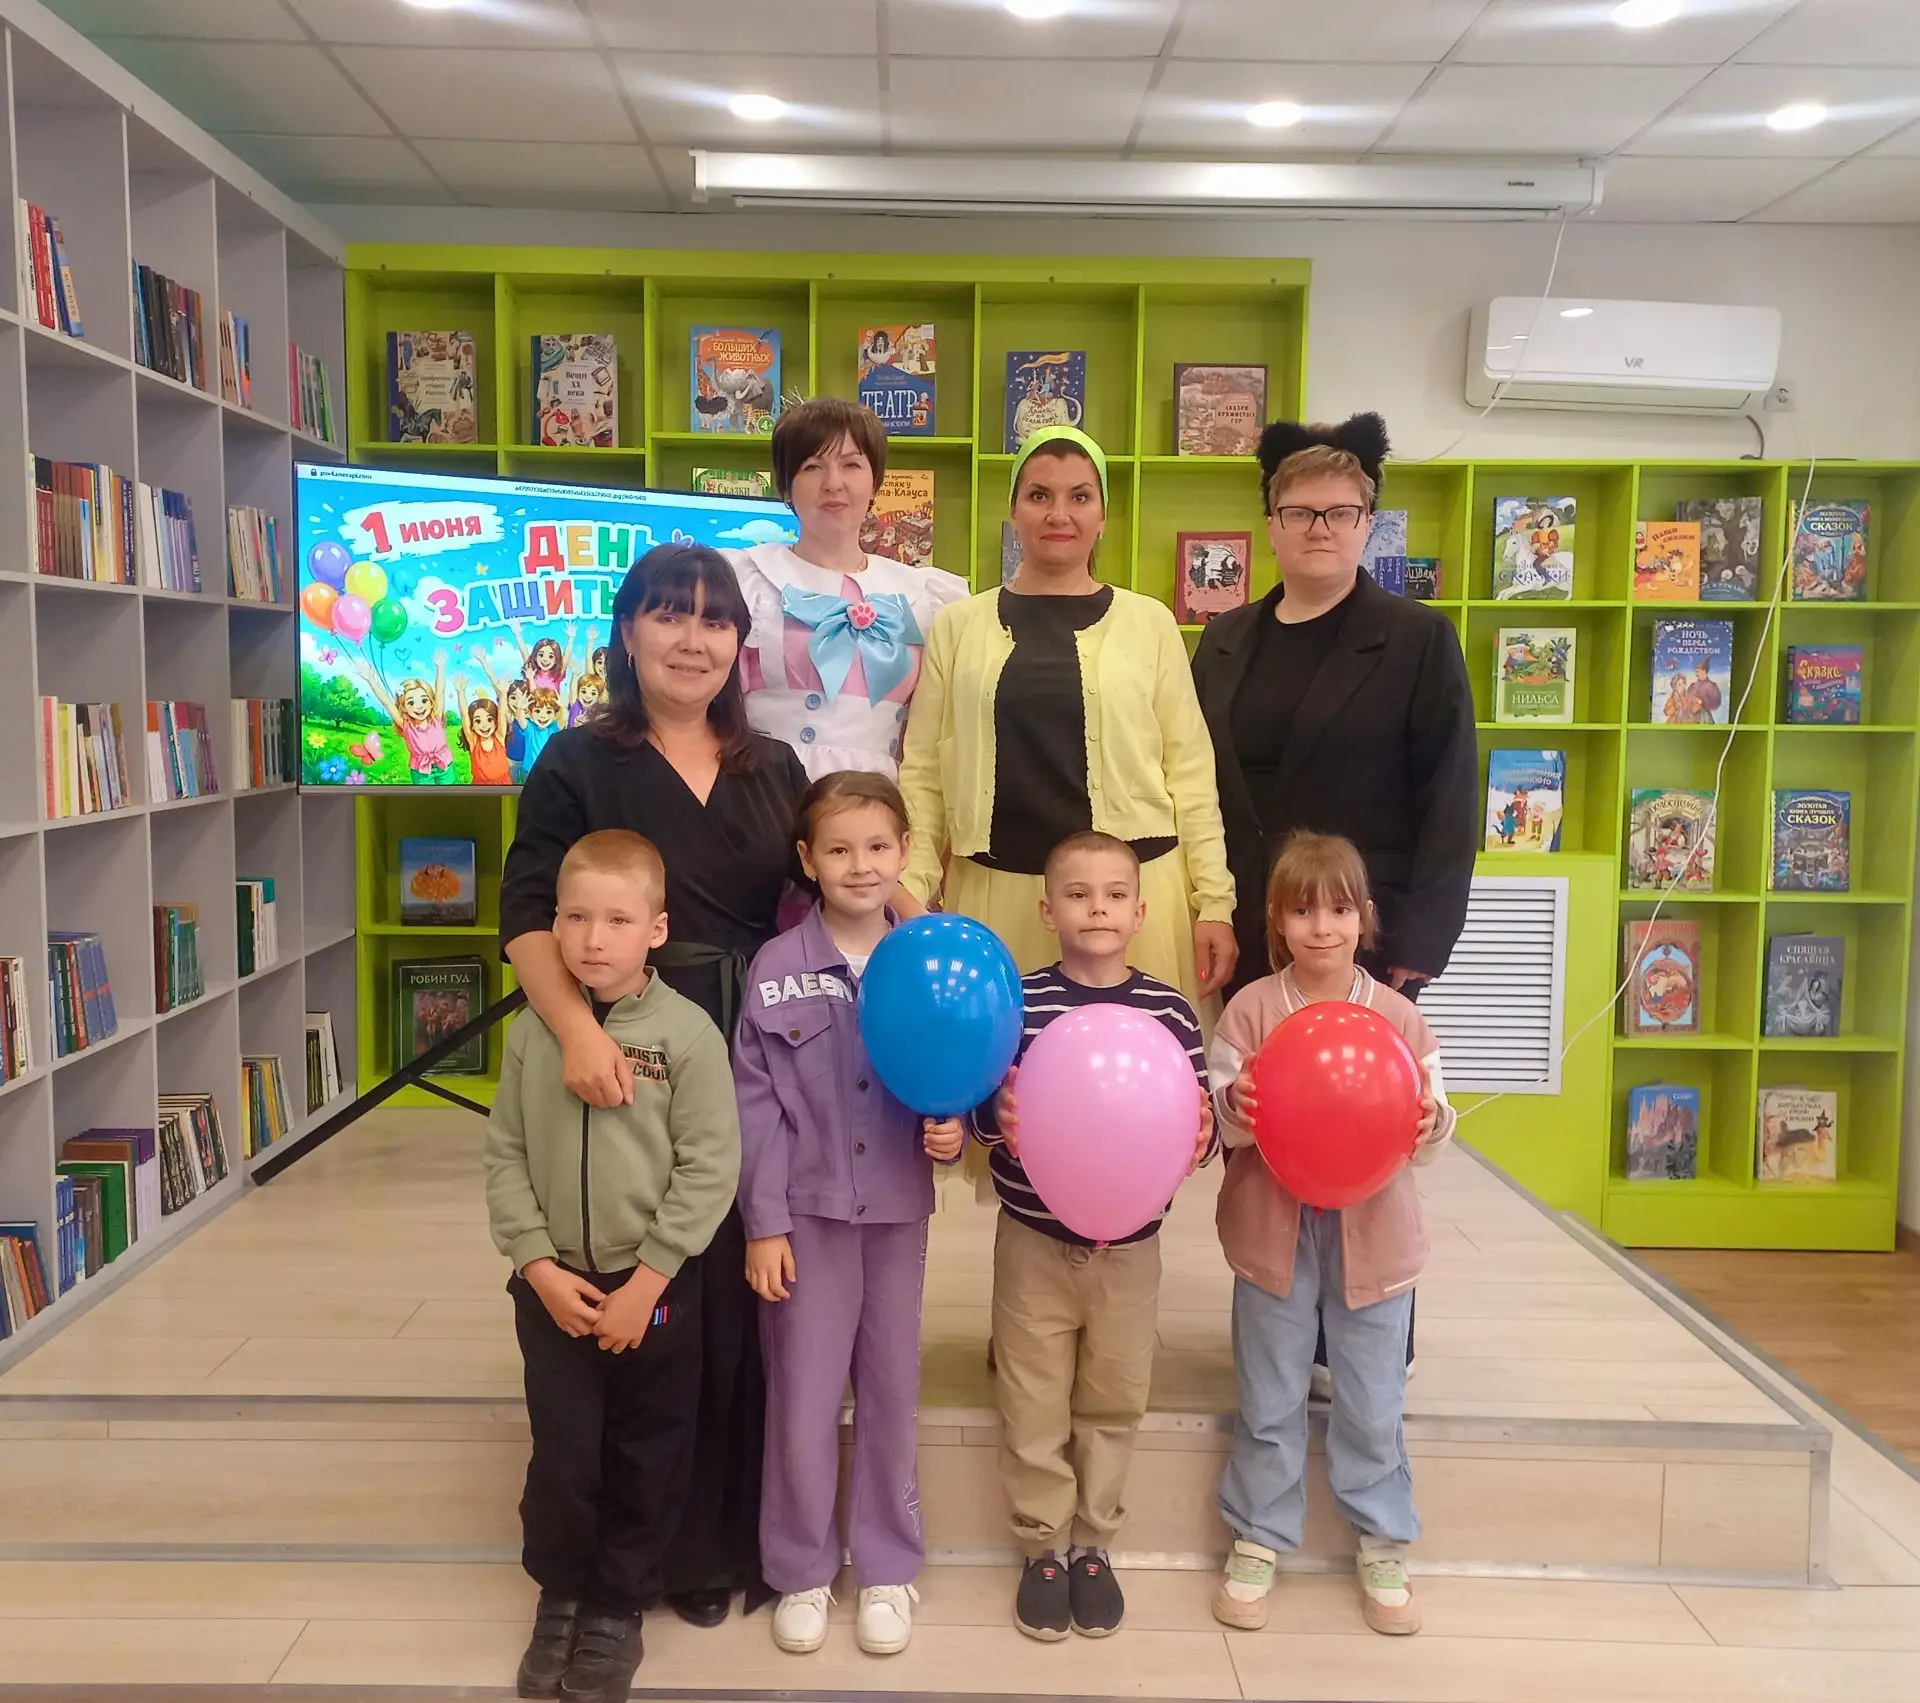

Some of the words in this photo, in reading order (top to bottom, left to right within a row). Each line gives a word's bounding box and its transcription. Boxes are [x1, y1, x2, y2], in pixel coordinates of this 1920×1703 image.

[861, 389, 918, 419] ТЕАТР
[1810, 522, 1854, 531] СКАЗОК
[360, 511, 392, 554] 1
[399, 516, 482, 544] июня
[1681, 630, 1708, 639] НОЧЬ
[1512, 693, 1559, 704] НИЛЬСА
[1787, 815, 1837, 825] СКАЗОК
[410, 976, 447, 984] РОБИН
[450, 975, 471, 983] ГУД
